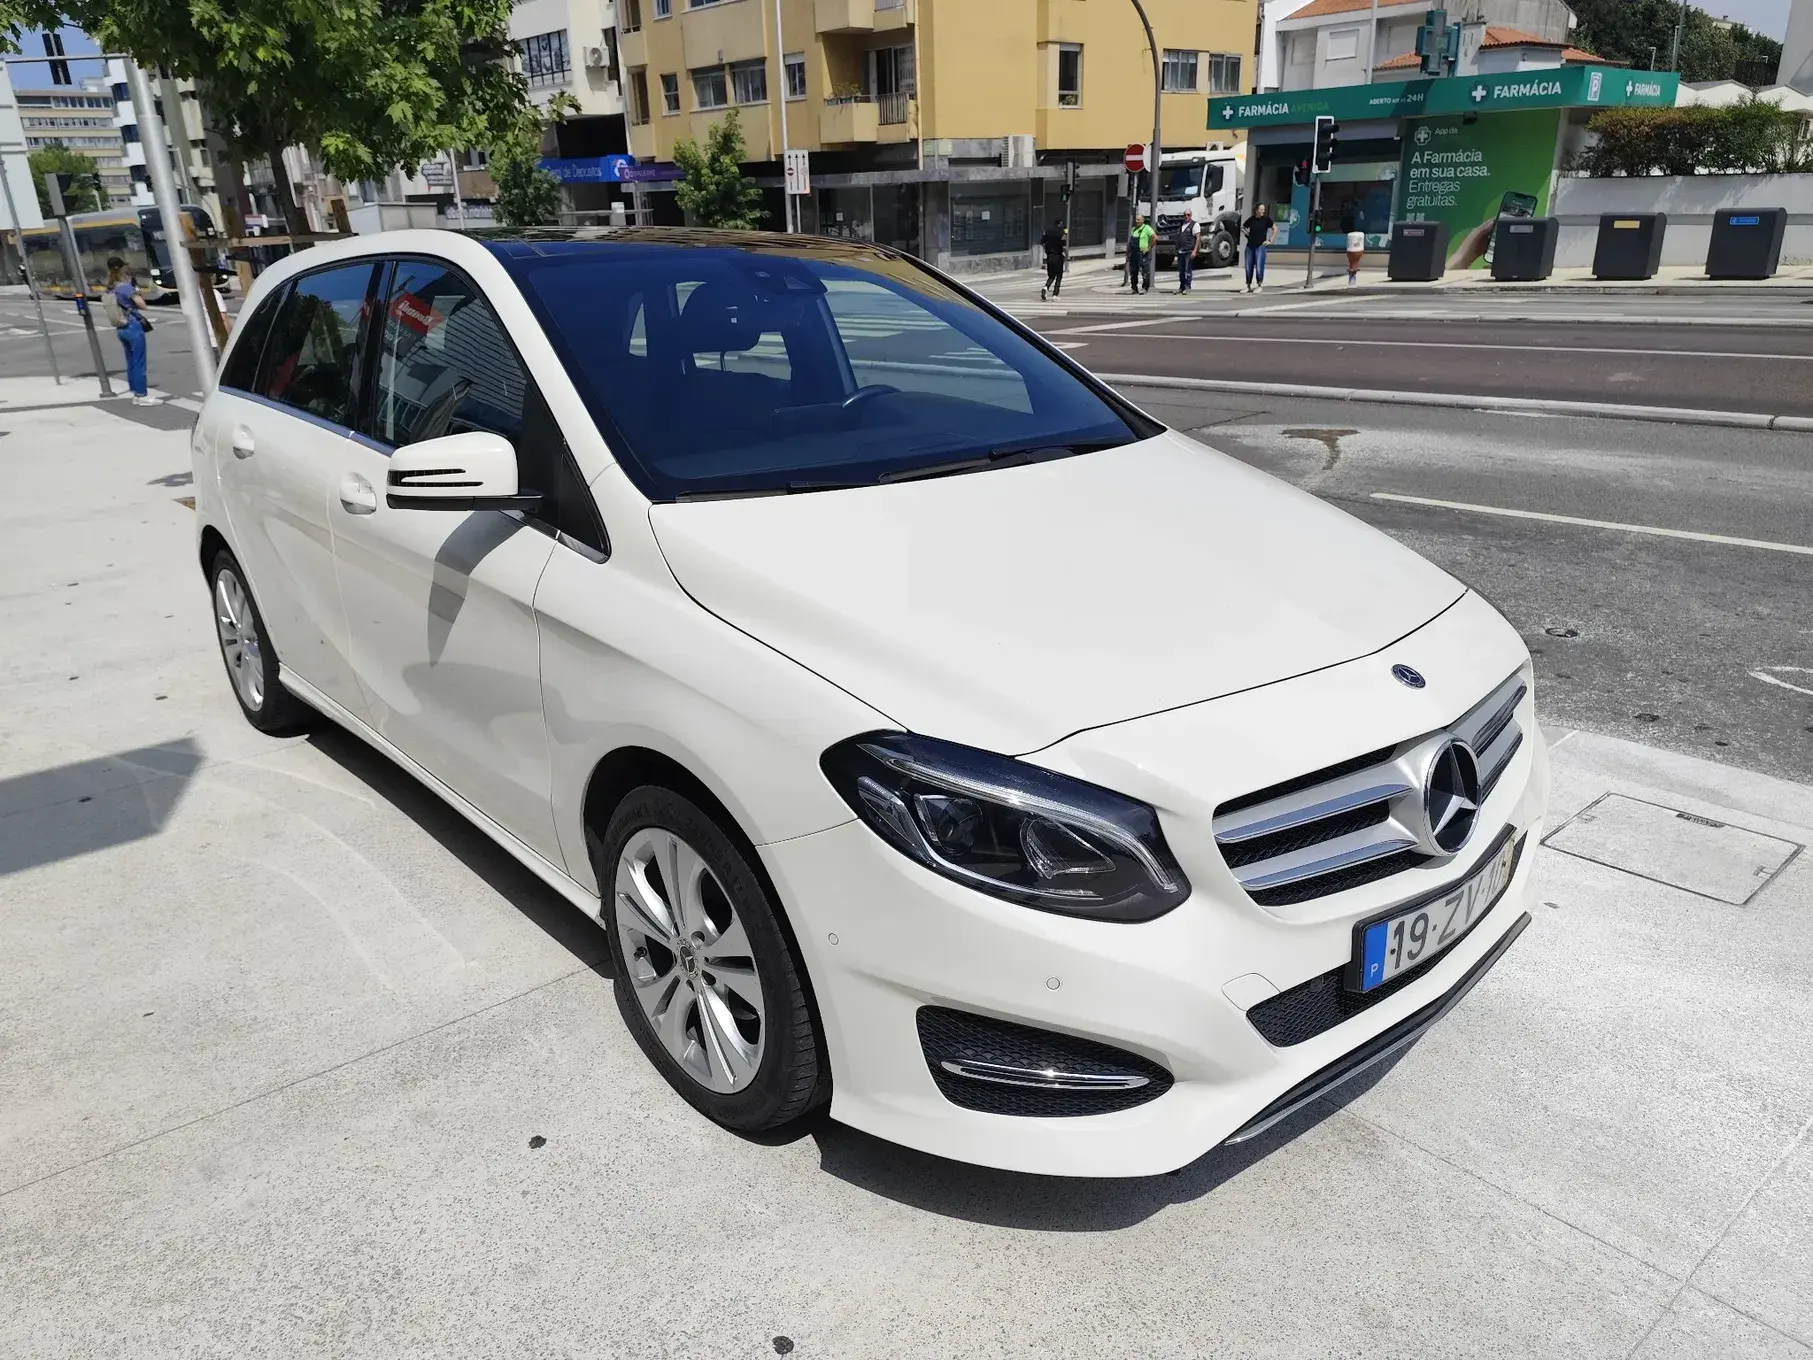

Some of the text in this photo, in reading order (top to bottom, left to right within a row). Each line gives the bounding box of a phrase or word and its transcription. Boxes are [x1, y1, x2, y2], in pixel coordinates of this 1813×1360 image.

[1493, 80, 1562, 99] FARMÁCIA
[1634, 80, 1661, 97] FARMÁCIA
[1369, 97, 1392, 105] ABERTO
[1406, 93, 1424, 103] 24H
[1238, 101, 1330, 118] FARMÁCIA AVENIDA
[1411, 149, 1483, 164] A Farmácia
[1410, 165, 1491, 178] em sua casa.
[1409, 180, 1461, 194] Entregas
[1406, 194, 1457, 209] gratuitas.
[1370, 962, 1379, 978] P
